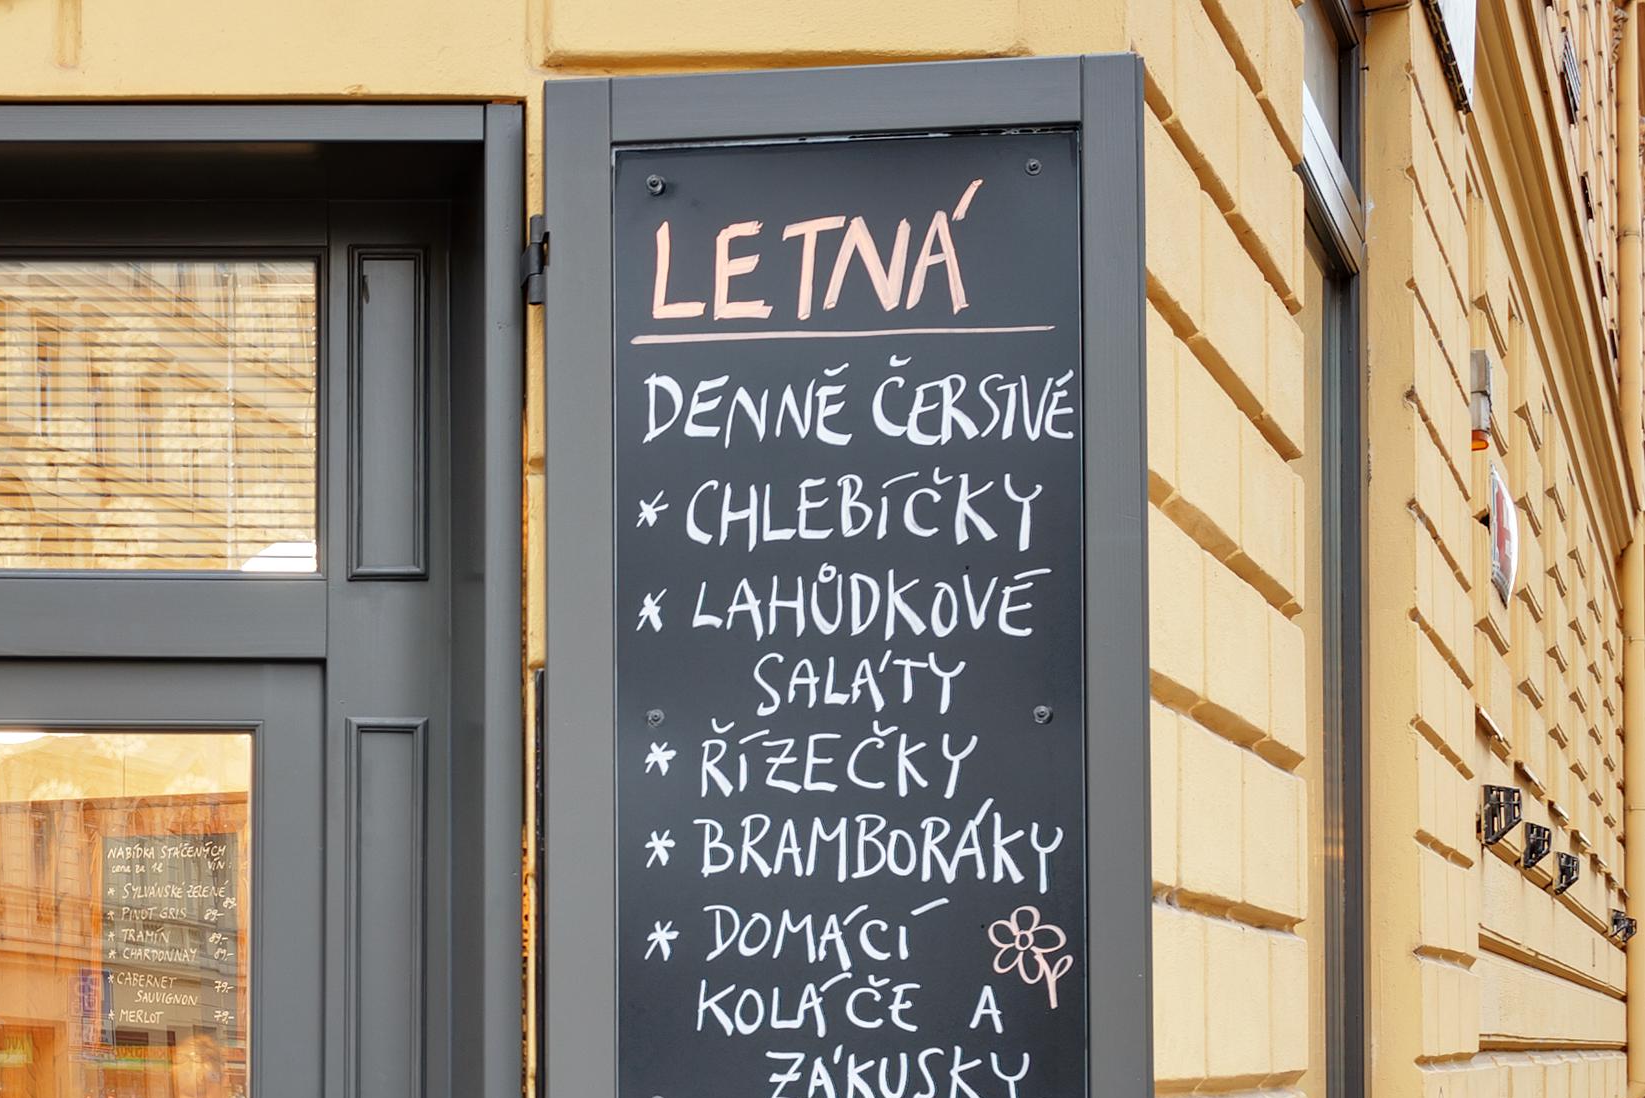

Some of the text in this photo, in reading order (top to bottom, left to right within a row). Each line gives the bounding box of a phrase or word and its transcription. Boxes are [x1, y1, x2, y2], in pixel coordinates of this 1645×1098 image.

[651, 178, 983, 321] LETNÁ
[642, 354, 1074, 449] DENNĚ ČERSTVÉ
[685, 466, 1043, 553] CHLEBÍČKY
[692, 562, 1052, 642] LAHŮDKOVÉ
[753, 649, 967, 717] SALÁTY
[700, 717, 979, 800] ŘÍZEČKY
[107, 841, 227, 860] NABÍDKA STÁČENÝCH
[692, 797, 1064, 895] BRAMBORÁKY
[121, 906, 157, 921] PINOT
[159, 907, 187, 920] GRIS
[122, 881, 185, 899] SYLVÁNSKÉ
[121, 927, 171, 944] TRAMÍN
[122, 948, 197, 962] CHARDONNAY
[702, 897, 950, 972] DOMÁCÍ
[116, 972, 177, 989] CABERNET
[135, 990, 198, 1006] SAUVIGNON
[696, 971, 1004, 1038] KOLÁČE A
[118, 1009, 164, 1024] MERLOT
